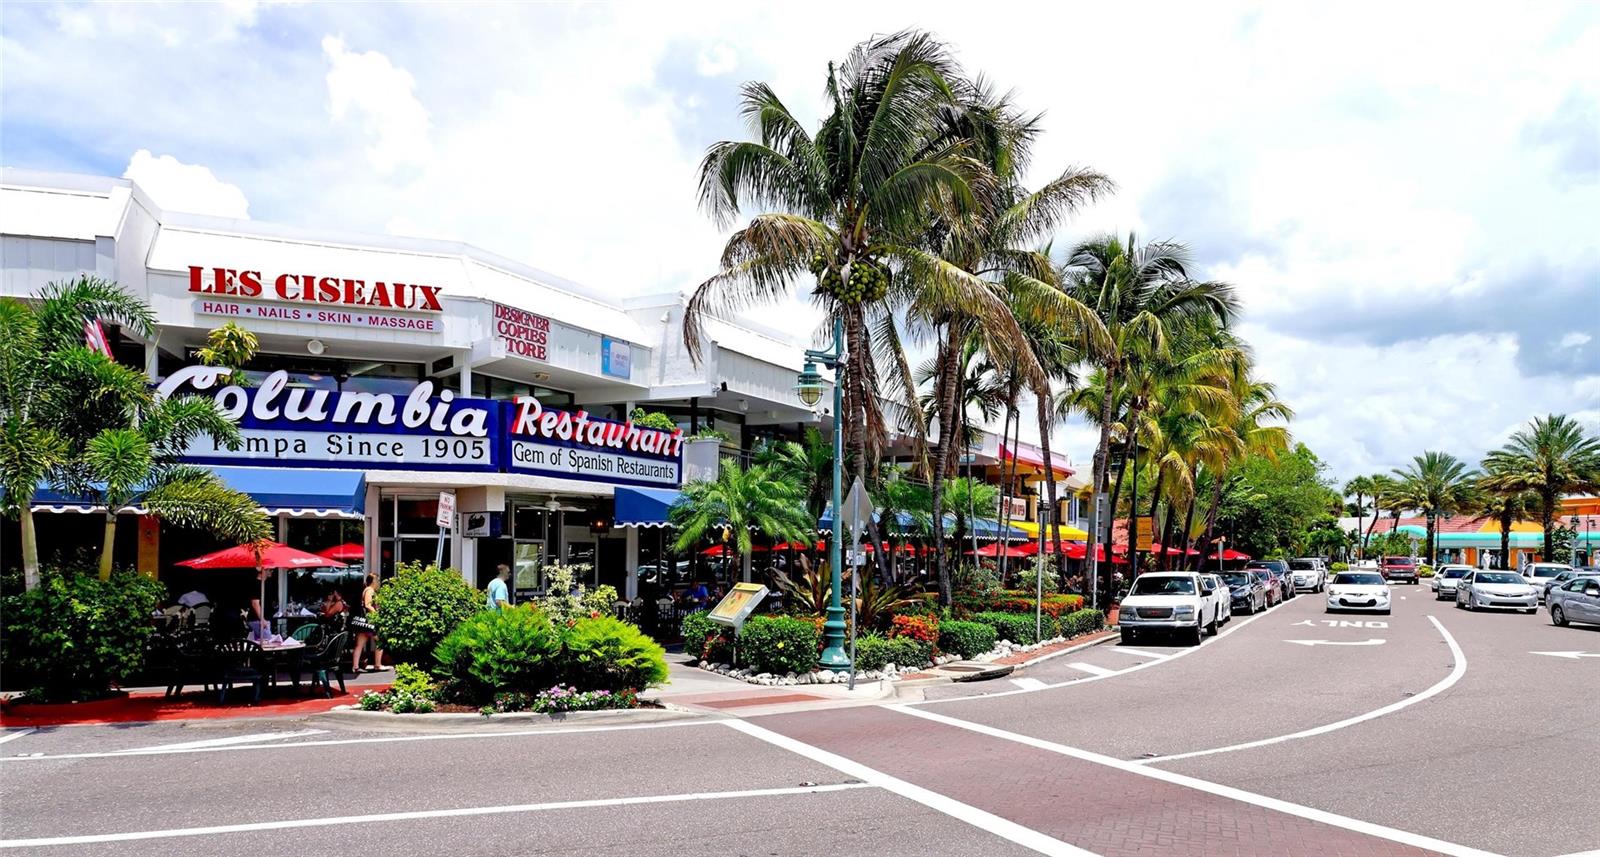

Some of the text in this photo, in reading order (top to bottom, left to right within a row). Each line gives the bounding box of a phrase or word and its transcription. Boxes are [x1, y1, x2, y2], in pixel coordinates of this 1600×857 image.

[188, 266, 443, 311] LES CISEAUX
[203, 302, 434, 330] HAIR NAILS SKIN MASSAGE
[495, 304, 550, 332] DESIGNER
[498, 320, 547, 345] COPIES
[498, 335, 547, 360] TORE
[155, 365, 488, 437] Columbia
[512, 395, 683, 456] Restaurant
[326, 433, 404, 457] Since
[422, 438, 485, 460] 1905
[513, 442, 674, 479] Gem of Spanish Restaurants
[1290, 619, 1389, 629] ONLY
